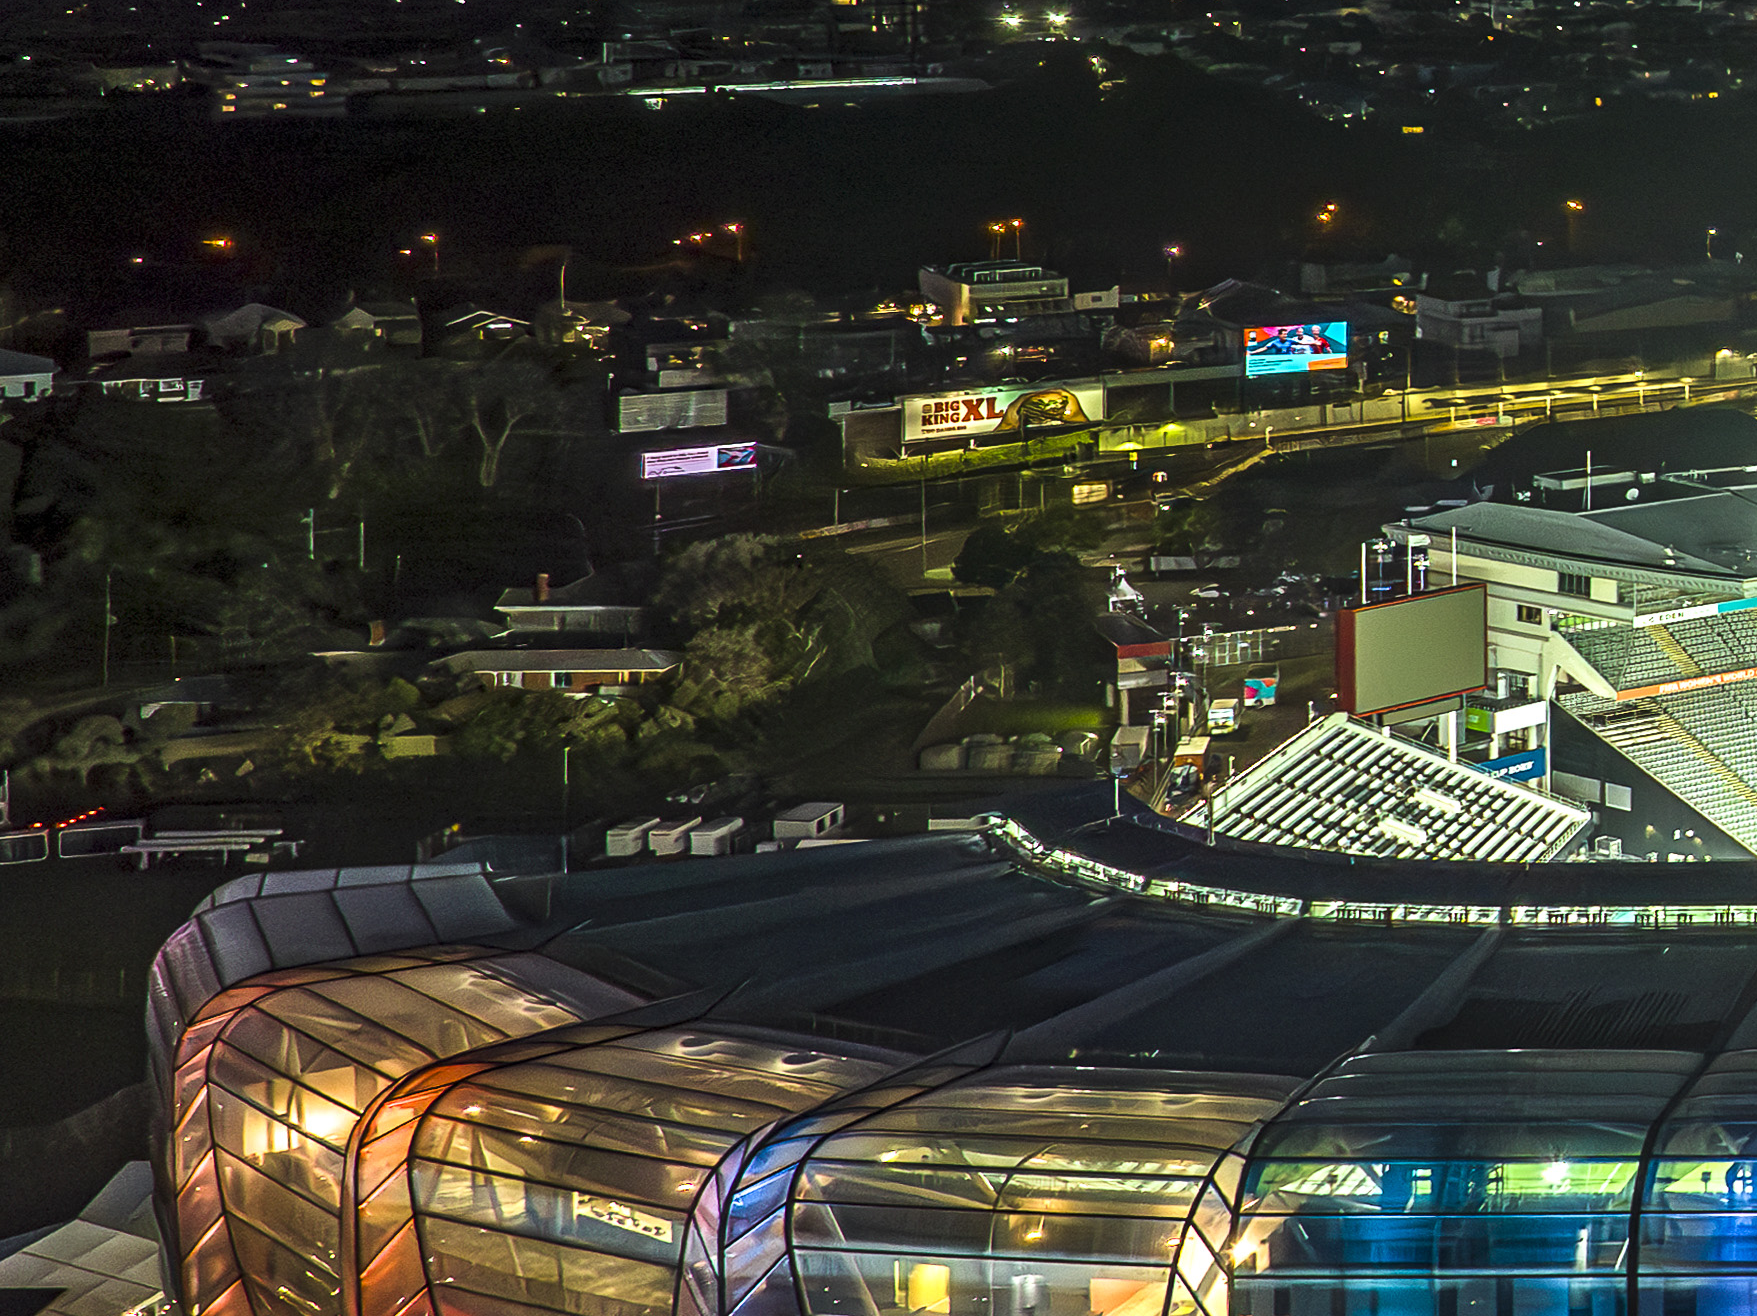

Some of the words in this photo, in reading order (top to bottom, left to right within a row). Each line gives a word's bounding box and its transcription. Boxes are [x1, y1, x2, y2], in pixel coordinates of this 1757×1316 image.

[933, 400, 960, 413] BIG
[961, 397, 1004, 422] XL
[921, 412, 960, 426] KING
[1722, 669, 1755, 682] WORLD
